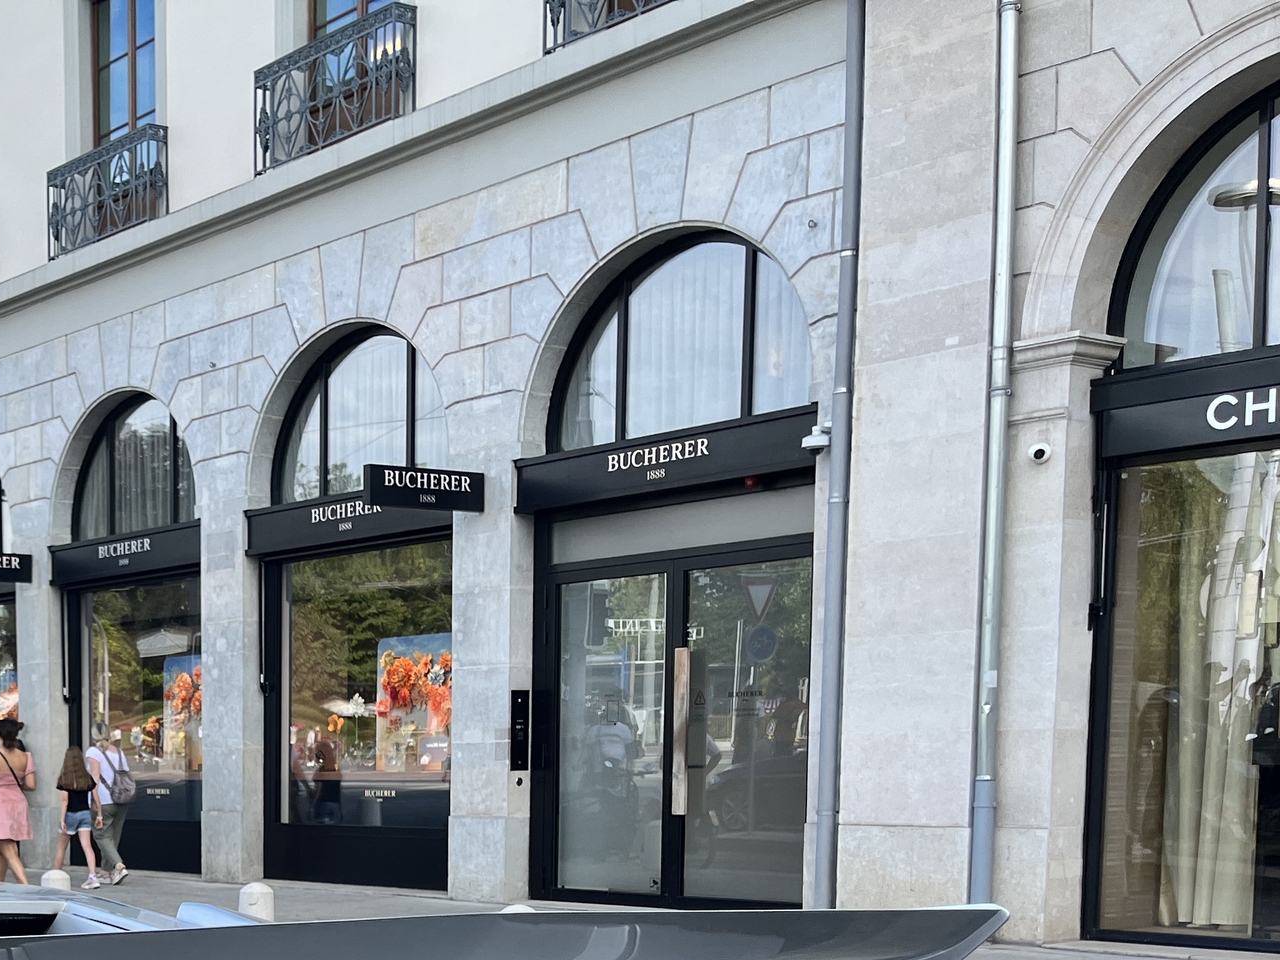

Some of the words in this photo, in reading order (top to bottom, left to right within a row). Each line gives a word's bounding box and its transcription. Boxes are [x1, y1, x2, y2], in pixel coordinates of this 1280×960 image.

[1206, 388, 1277, 430] CH
[607, 438, 710, 472] BUCHERER
[383, 469, 472, 492] BUCHERER
[646, 468, 666, 480] 1888
[419, 494, 436, 503] 1888
[338, 522, 352, 531] 1888
[98, 538, 151, 559] BUCHERER
